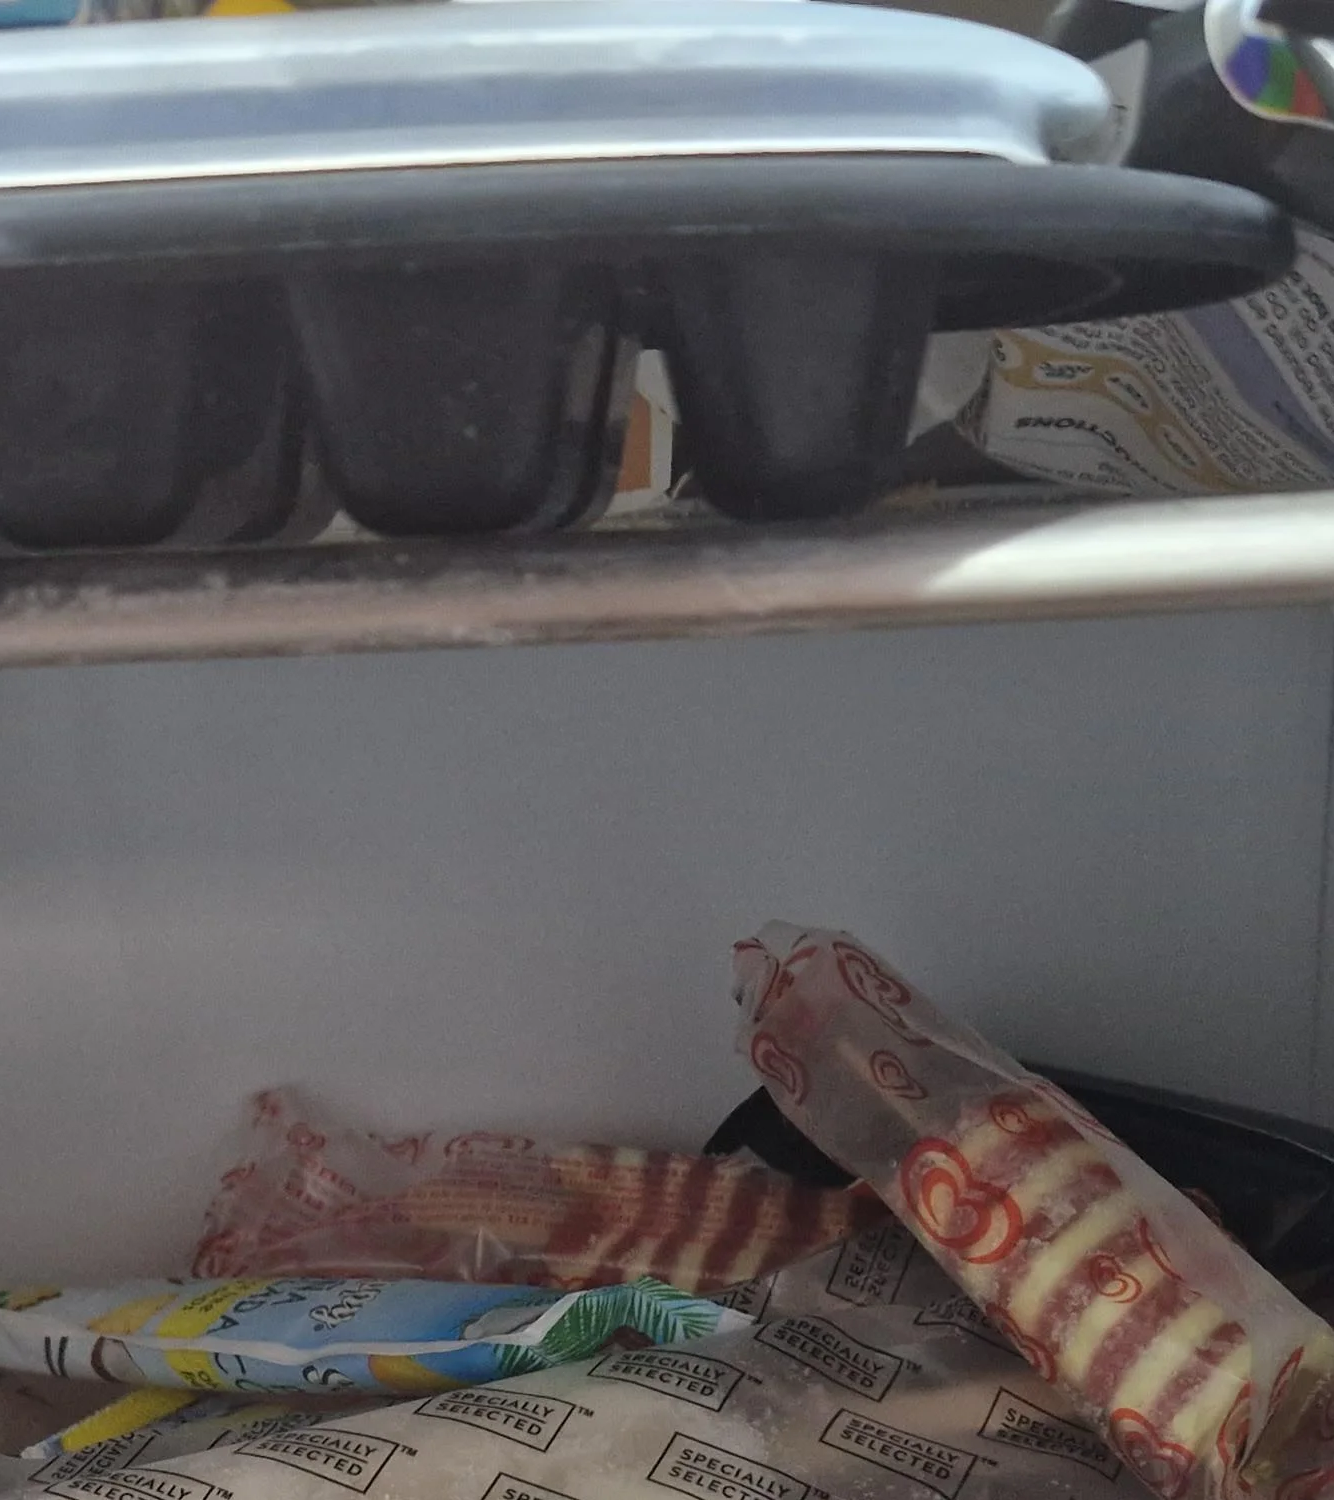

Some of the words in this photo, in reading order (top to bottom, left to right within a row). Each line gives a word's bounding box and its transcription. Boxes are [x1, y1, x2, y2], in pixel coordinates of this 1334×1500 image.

[618, 1351, 727, 1380] SPECIALLY
[773, 1329, 875, 1391] SELECTED
[781, 1317, 885, 1375] SPECIALLY
[608, 1363, 717, 1399] SELECTED
[435, 1402, 543, 1438] SELECTED
[449, 1391, 556, 1419] SPECIALLY
[255, 1440, 364, 1478] SELECTED
[839, 1429, 952, 1481] SELECTED
[848, 1418, 961, 1464] SPECIALLY
[679, 1447, 791, 1500] SPECIALLY
